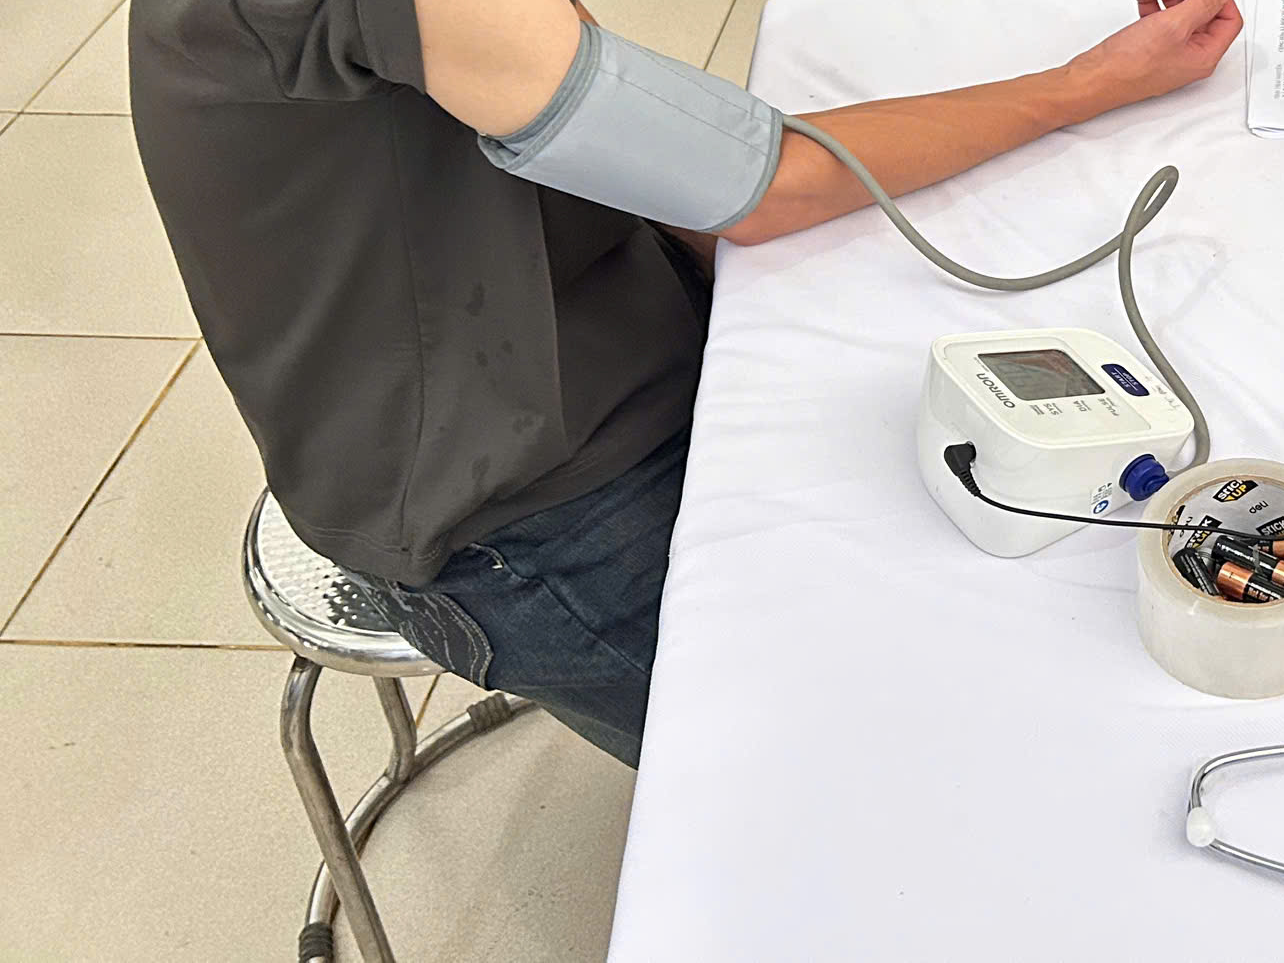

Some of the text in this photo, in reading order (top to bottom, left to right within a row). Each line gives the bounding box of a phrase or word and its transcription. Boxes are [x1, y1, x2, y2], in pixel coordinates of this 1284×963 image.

[1043, 403, 1060, 416] SYS
[1073, 400, 1088, 412] DIA
[1231, 484, 1247, 498] UP
[1248, 500, 1269, 513] deli
